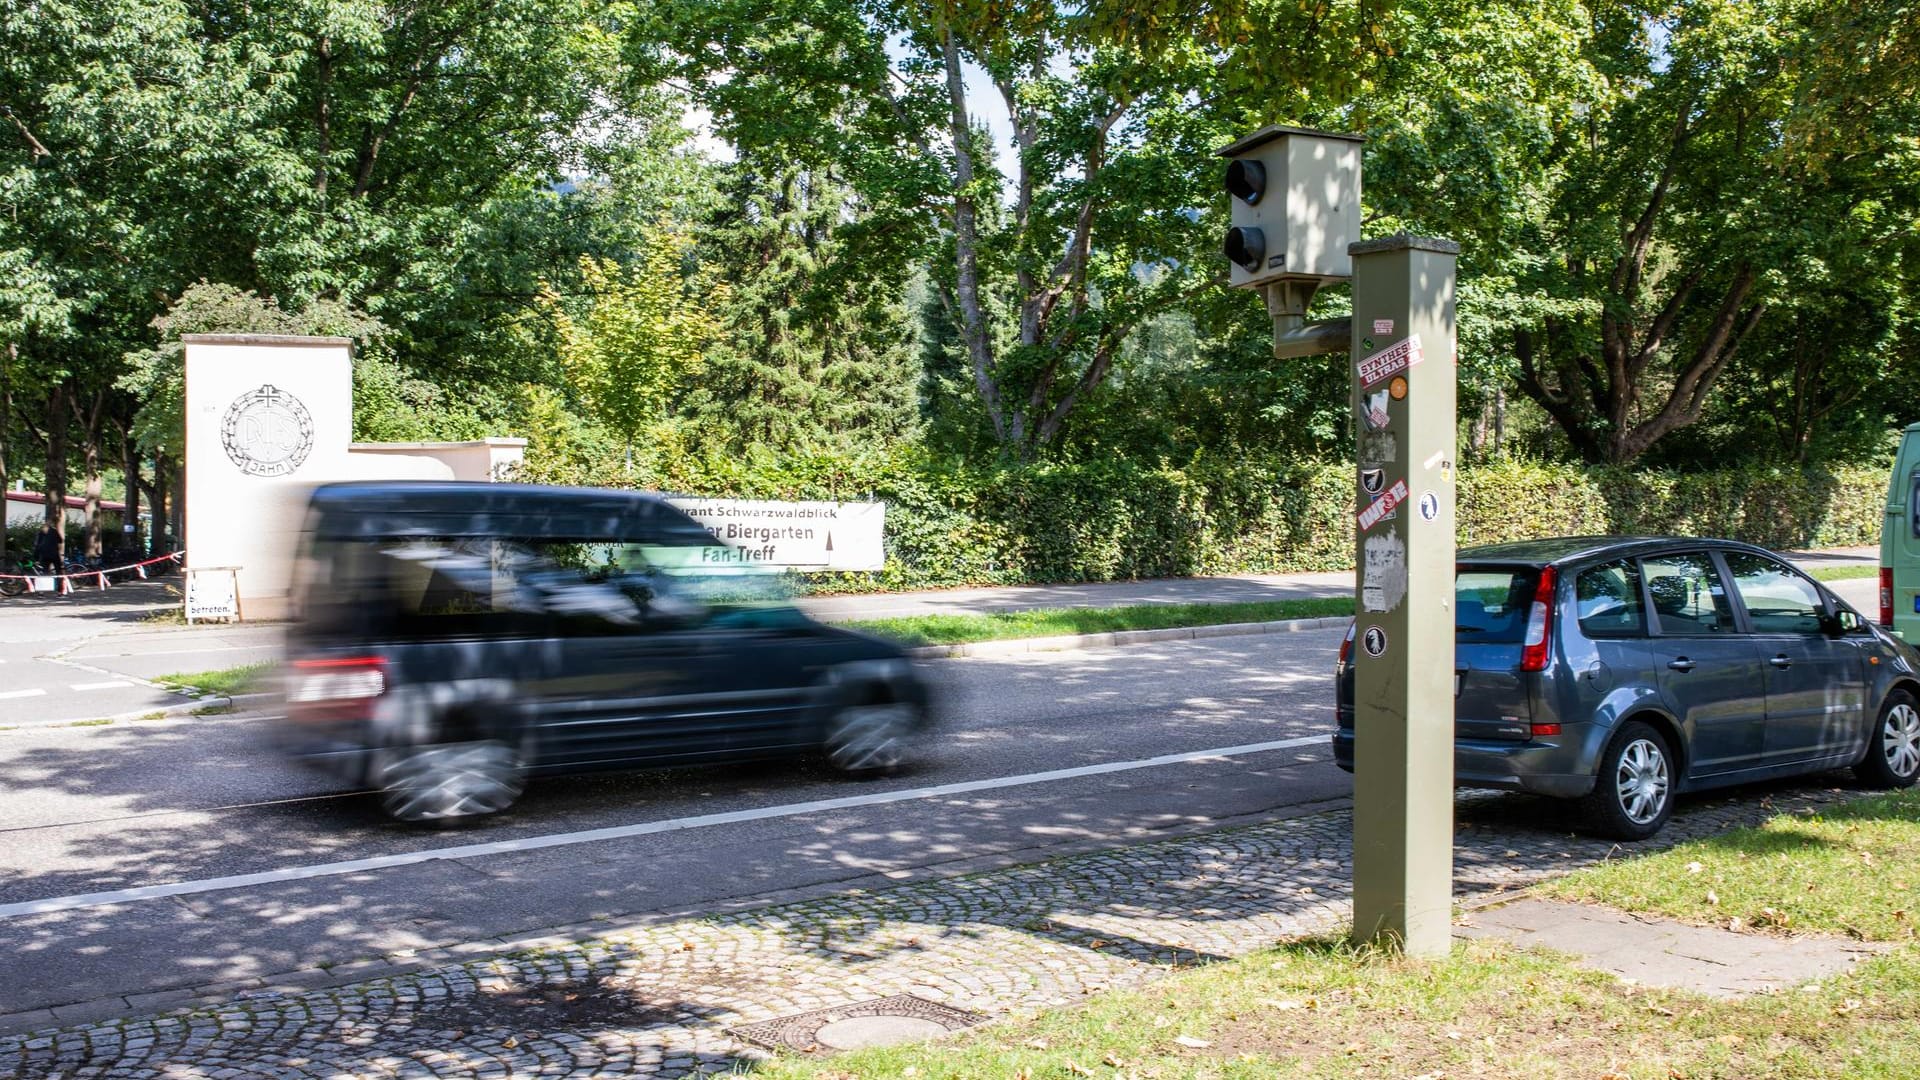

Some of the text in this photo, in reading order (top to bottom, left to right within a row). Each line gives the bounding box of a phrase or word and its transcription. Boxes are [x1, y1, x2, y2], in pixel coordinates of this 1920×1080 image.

[1365, 356, 1406, 384] ULTRAS
[718, 507, 837, 519] Schwarzwaldblick
[707, 523, 814, 543] er Biergarten
[702, 545, 776, 563] Fan-Treff
